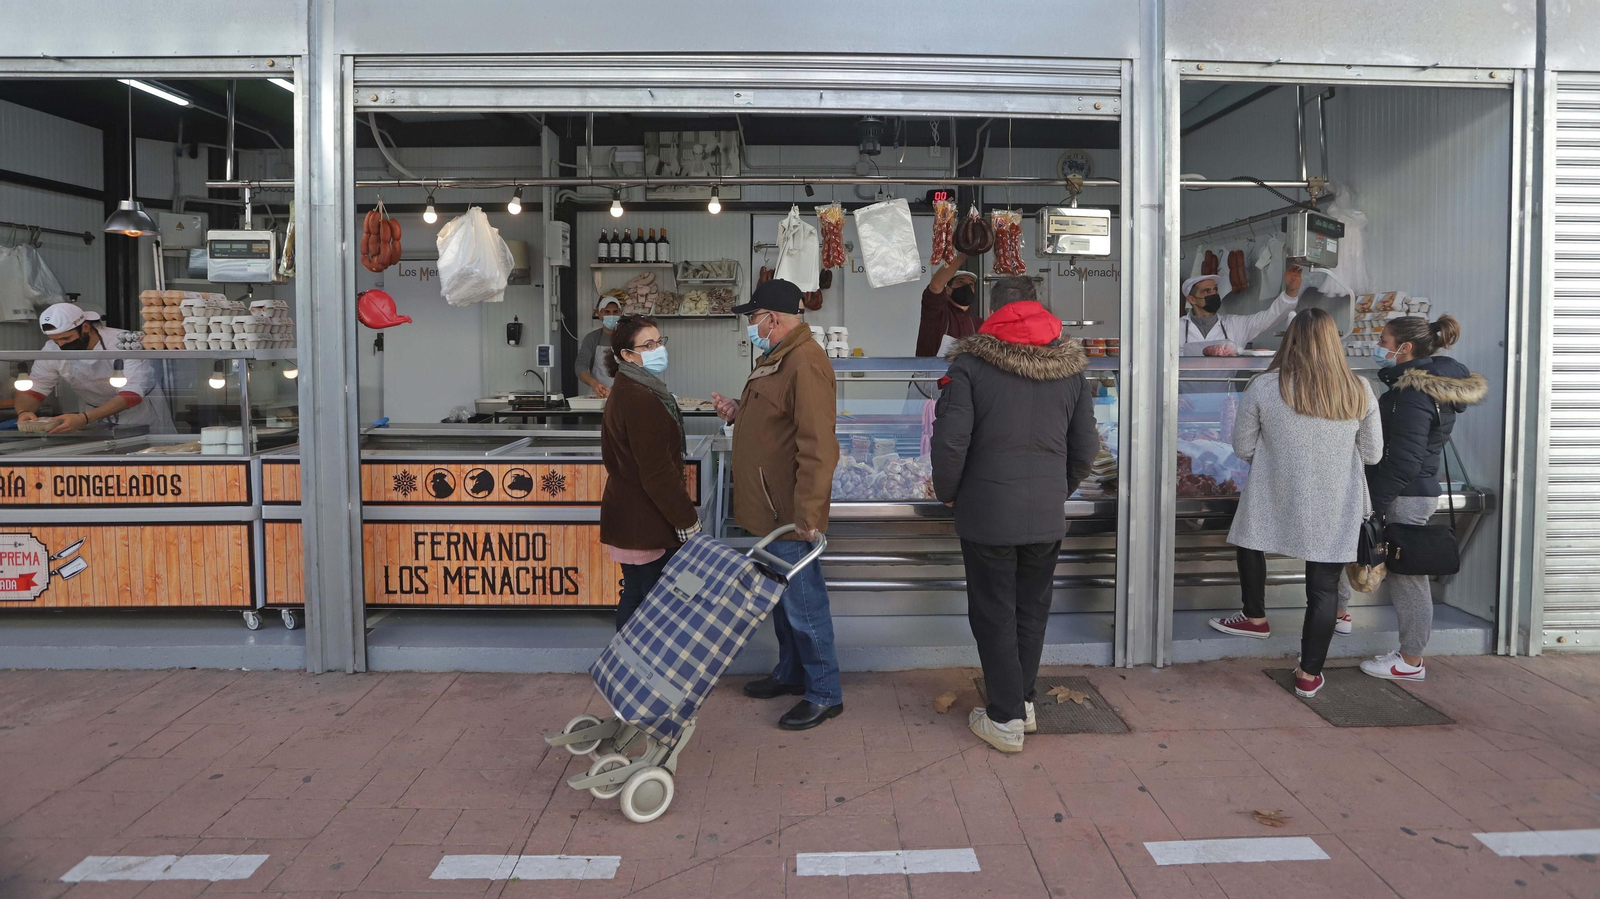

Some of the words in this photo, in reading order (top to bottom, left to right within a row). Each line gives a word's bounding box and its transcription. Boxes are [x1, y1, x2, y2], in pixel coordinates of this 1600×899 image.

[398, 262, 417, 277] Los
[851, 259, 866, 274] Lo
[1057, 262, 1076, 277] Los
[53, 474, 182, 497] CONGELADOS
[413, 531, 547, 562] FERNANDO
[0, 551, 40, 566] PREMA
[384, 565, 429, 595] LOS
[443, 565, 579, 596] MENACHOS
